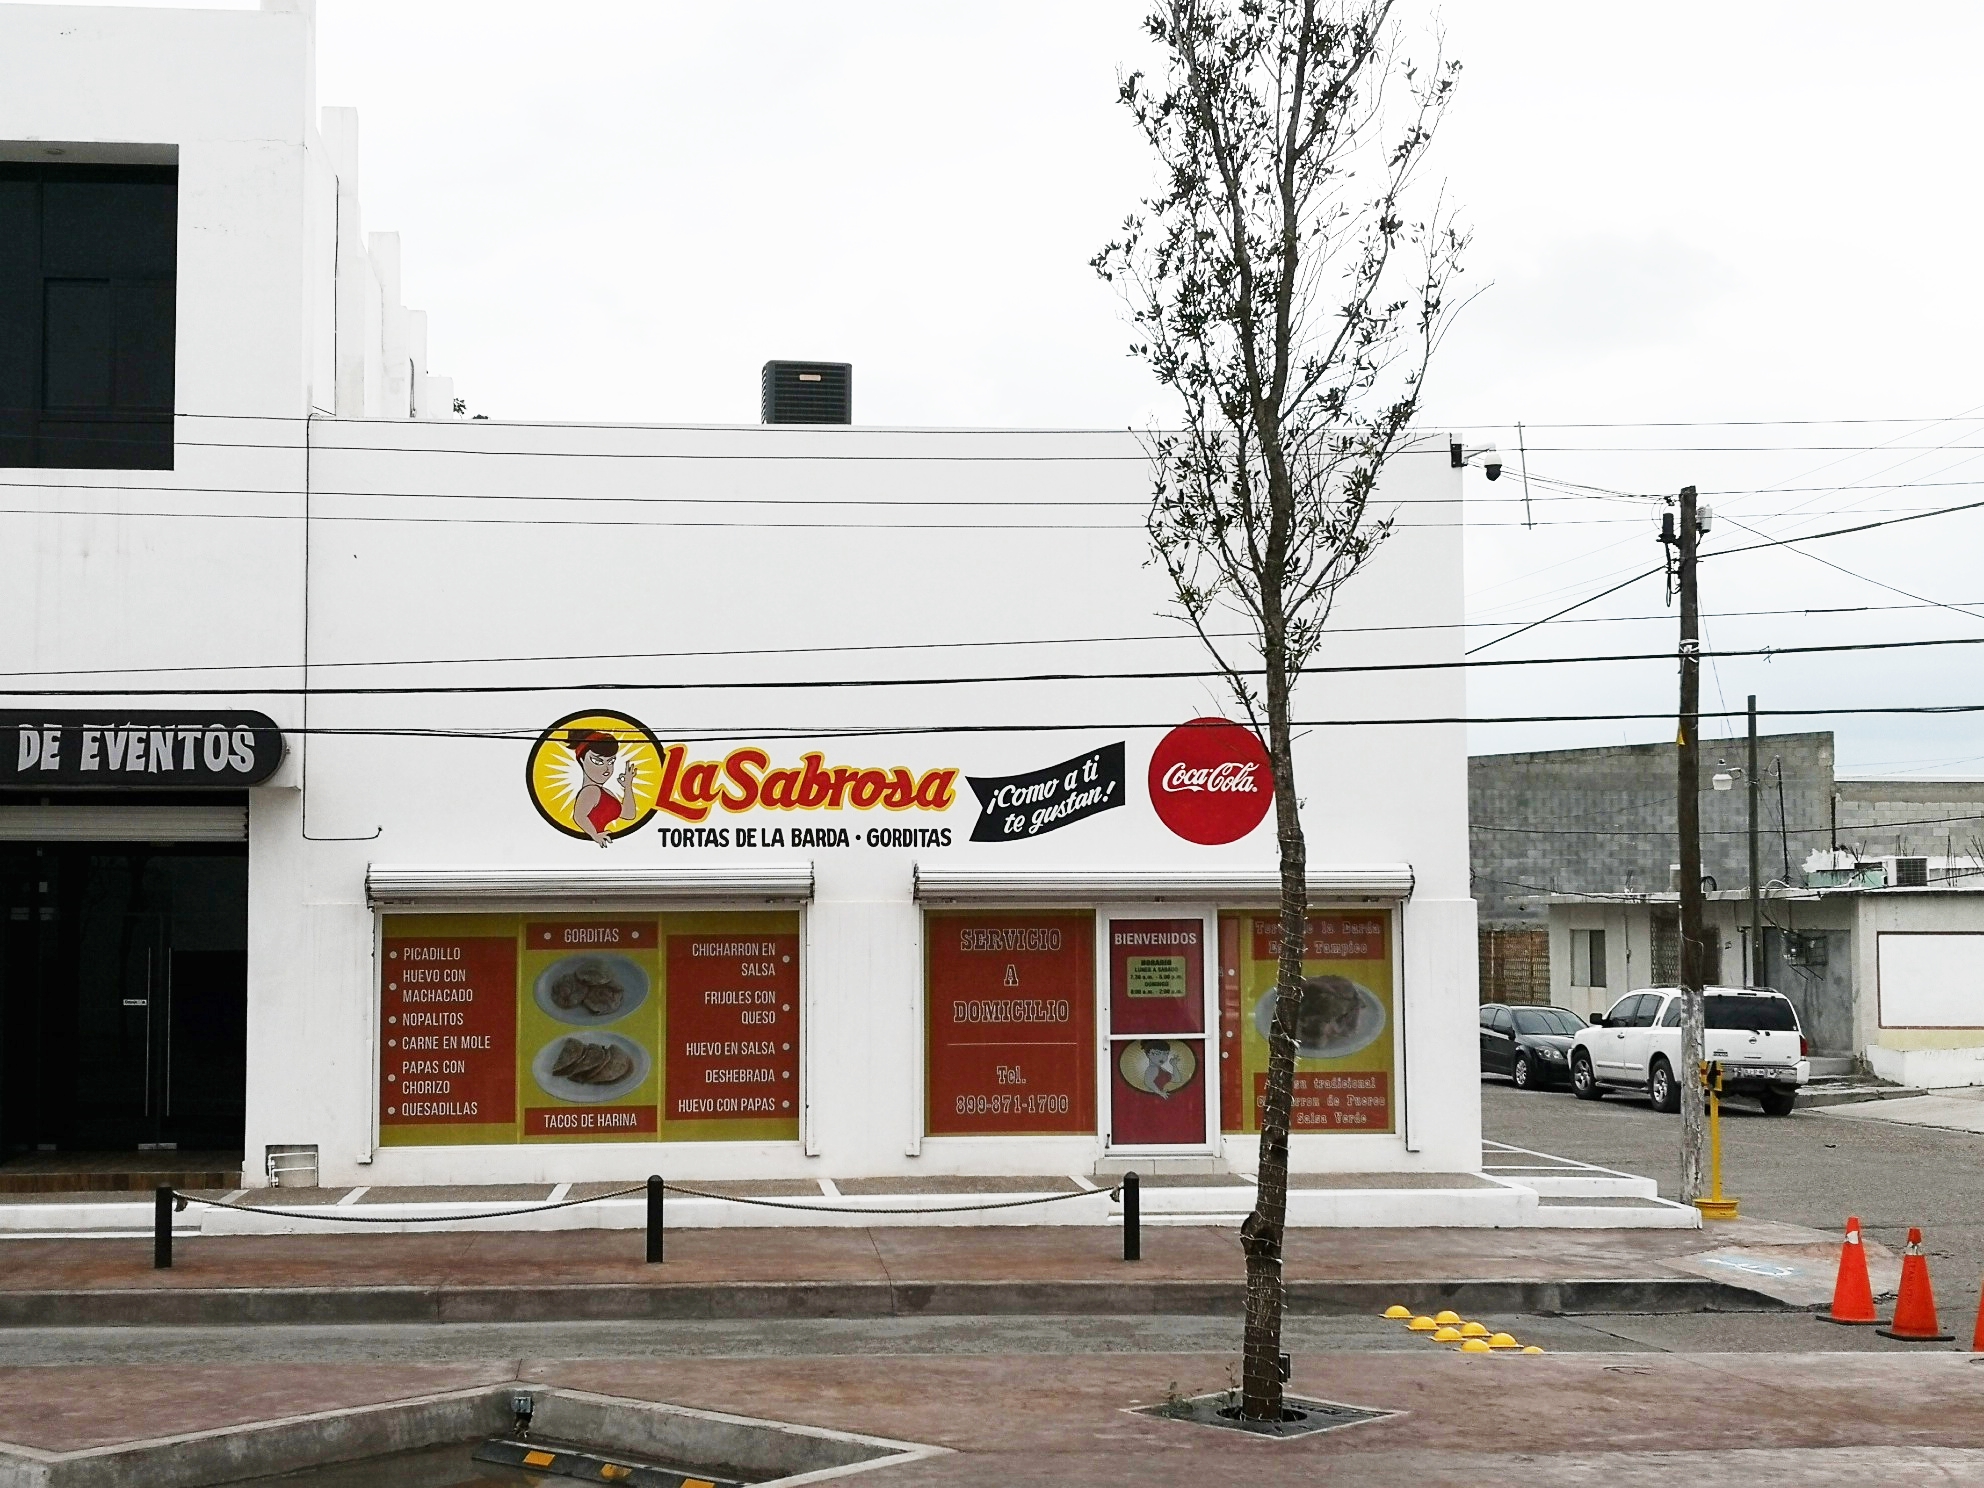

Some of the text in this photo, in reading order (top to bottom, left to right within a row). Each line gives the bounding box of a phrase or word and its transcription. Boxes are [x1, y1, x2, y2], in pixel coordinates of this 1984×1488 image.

[17, 721, 256, 774] DE EVENTOS
[1064, 769, 1078, 791] a
[1082, 754, 1100, 783] ti
[1003, 780, 1117, 835] te gustan!
[657, 827, 952, 848] TORTAS DE LA BARDA GORDITAS
[564, 928, 620, 943] GORDITAS
[960, 928, 1062, 951] SERVICIO
[1114, 932, 1197, 945] BIENVENIDOS
[403, 947, 461, 961] PICADILLO
[692, 942, 776, 957] CHICHARRON EN
[403, 969, 466, 983] HUEVO CON
[741, 962, 776, 976] SALSA
[1003, 964, 1019, 987] A
[402, 989, 473, 1002] MACHACADO
[704, 991, 776, 1005] FRIJOLES CON
[402, 1012, 464, 1026] NOPALITOS
[741, 1010, 776, 1025] QUESO
[953, 1000, 1070, 1023] DOMICILIO
[402, 1035, 491, 1050] CARNE EN MOLE
[686, 1041, 776, 1056] HUEVO EN SALSA
[402, 1060, 465, 1074] PAPAS CON
[705, 1069, 776, 1083] DESHEBRADA
[996, 1066, 1027, 1084] Tel.
[402, 1080, 450, 1094] CHORIZO
[402, 1102, 478, 1116] QUESADILLAS
[678, 1098, 776, 1112] HUEVO CON PAPAS
[956, 1094, 1069, 1114] 899-871-1700
[544, 1113, 637, 1128] TACOS DE HARINA
